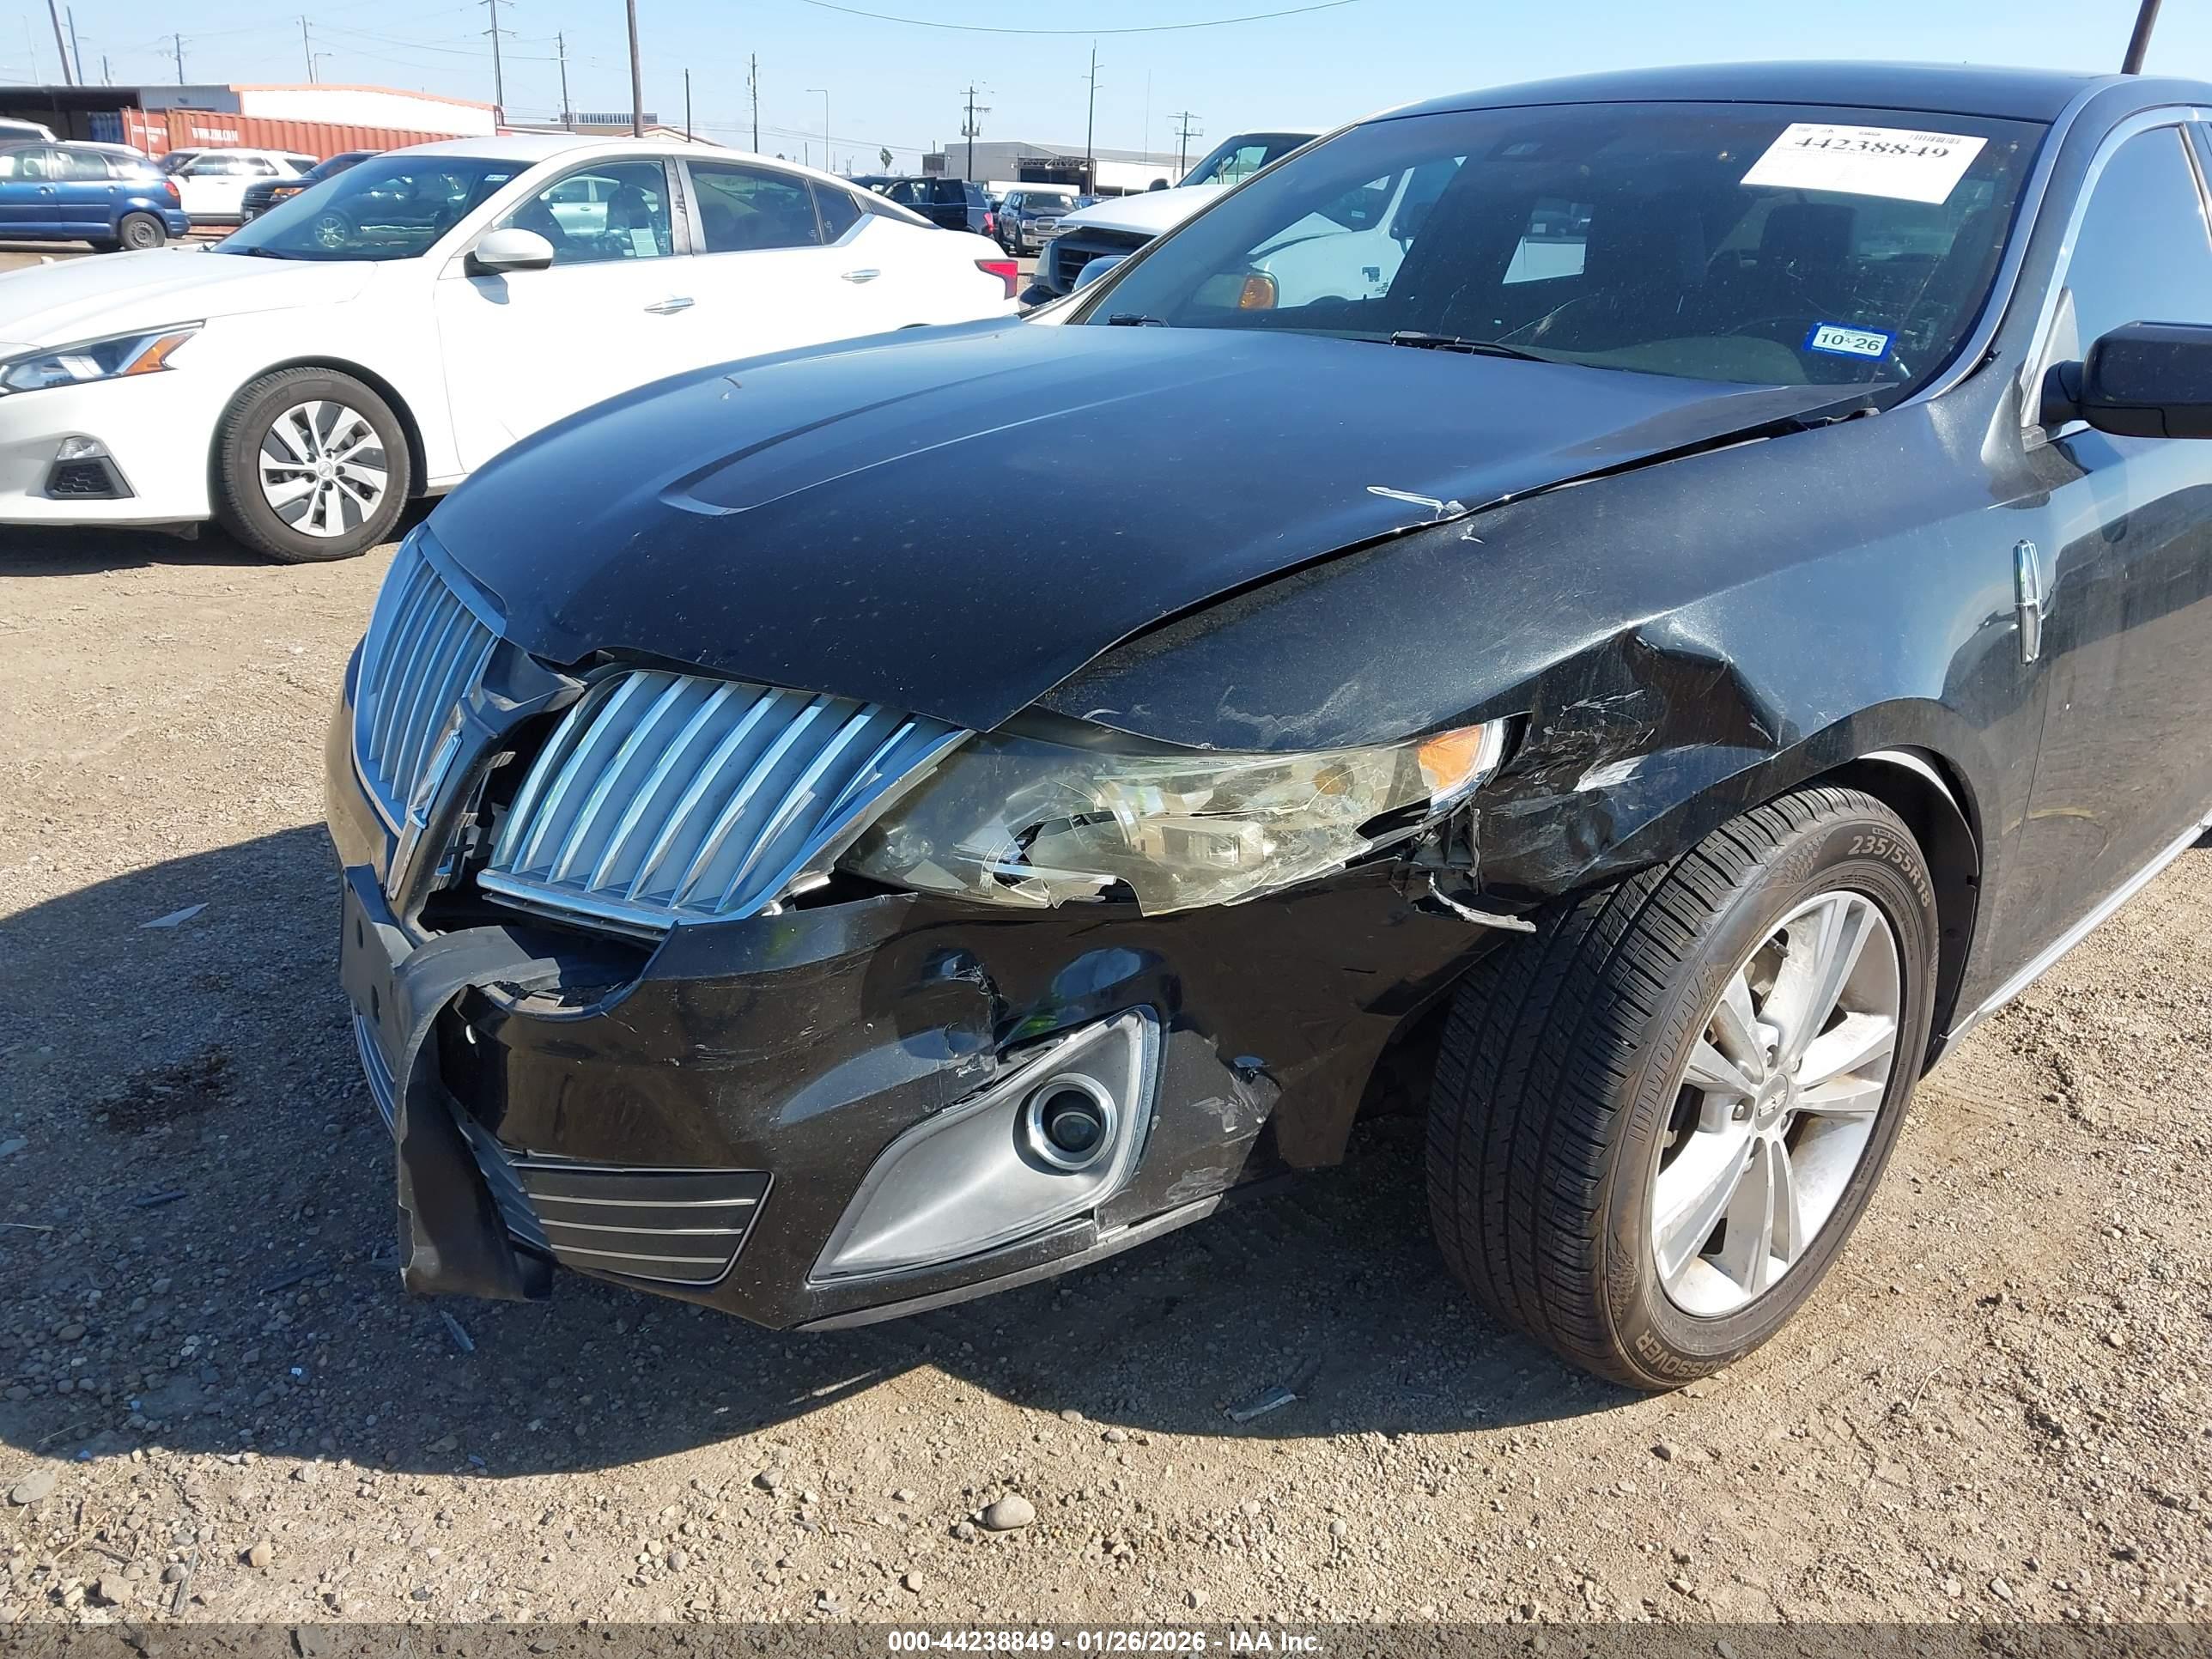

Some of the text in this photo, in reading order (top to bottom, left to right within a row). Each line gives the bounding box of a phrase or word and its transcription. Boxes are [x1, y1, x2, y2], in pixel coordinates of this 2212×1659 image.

[1795, 137, 1949, 158] 44238849
[1821, 333, 1844, 345] 10
[1853, 337, 1881, 351] 26
[1847, 835, 1931, 908] 235/55R18
